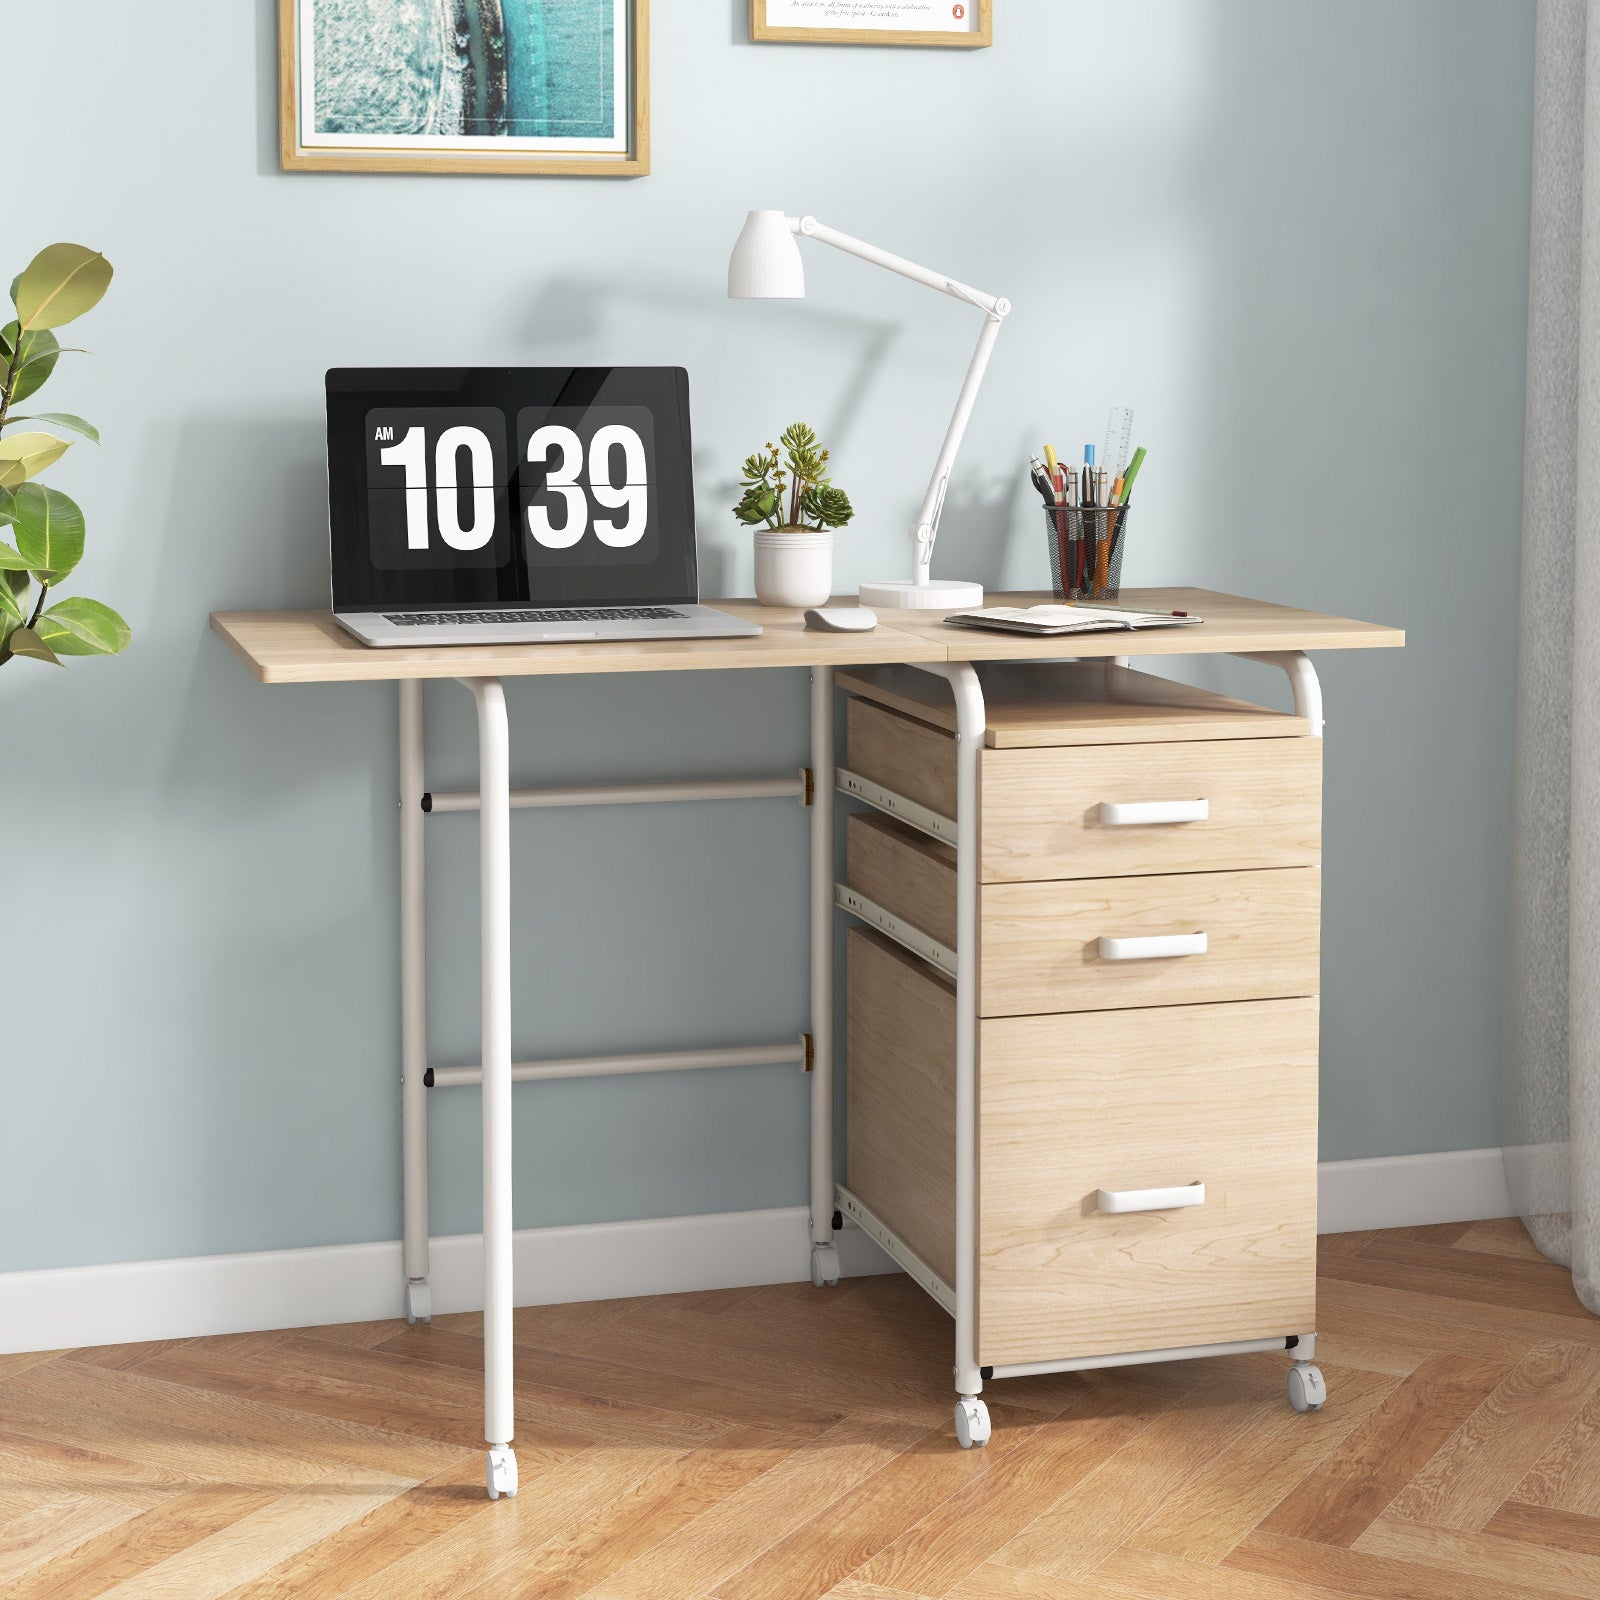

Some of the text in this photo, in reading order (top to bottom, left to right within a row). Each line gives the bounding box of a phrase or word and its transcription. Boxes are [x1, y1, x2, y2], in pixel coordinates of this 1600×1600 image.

[375, 424, 648, 551] AM 10 39
